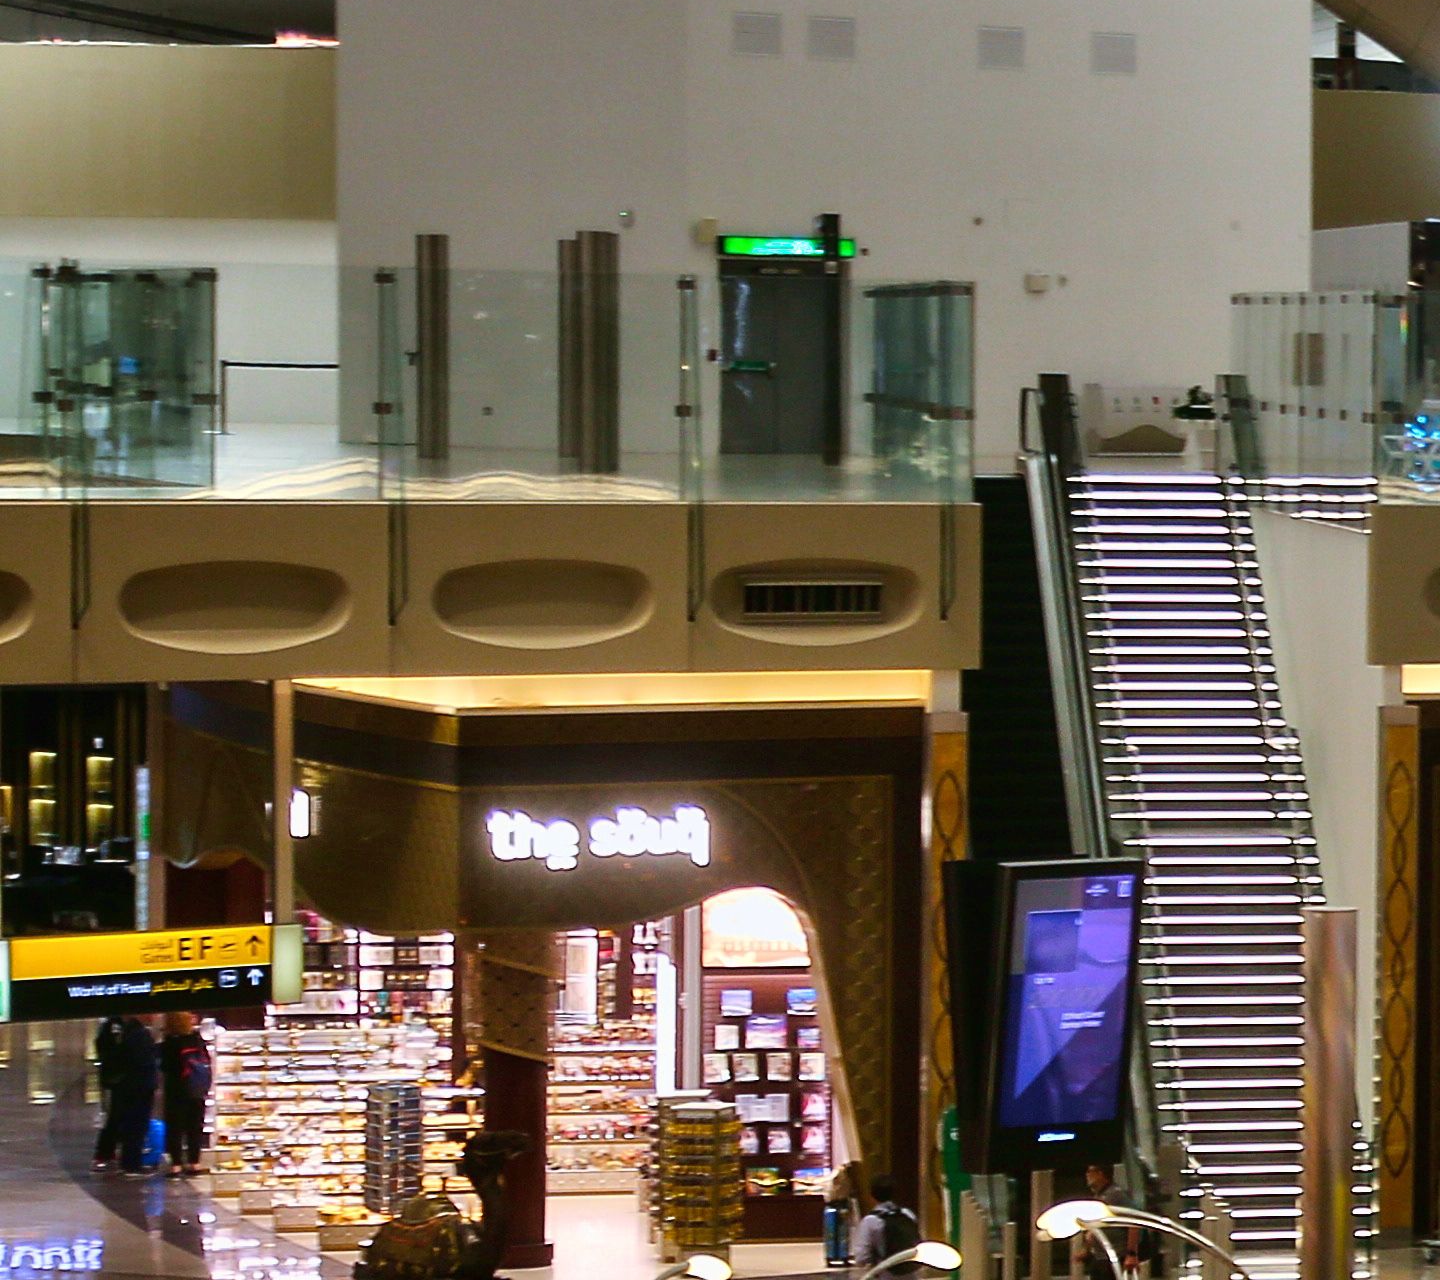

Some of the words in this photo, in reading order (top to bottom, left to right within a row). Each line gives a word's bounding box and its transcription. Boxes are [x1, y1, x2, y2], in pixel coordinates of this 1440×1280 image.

[179, 937, 192, 961] E
[200, 936, 213, 960] F
[68, 985, 105, 998] World
[105, 984, 120, 996] of
[120, 981, 151, 995] Food
